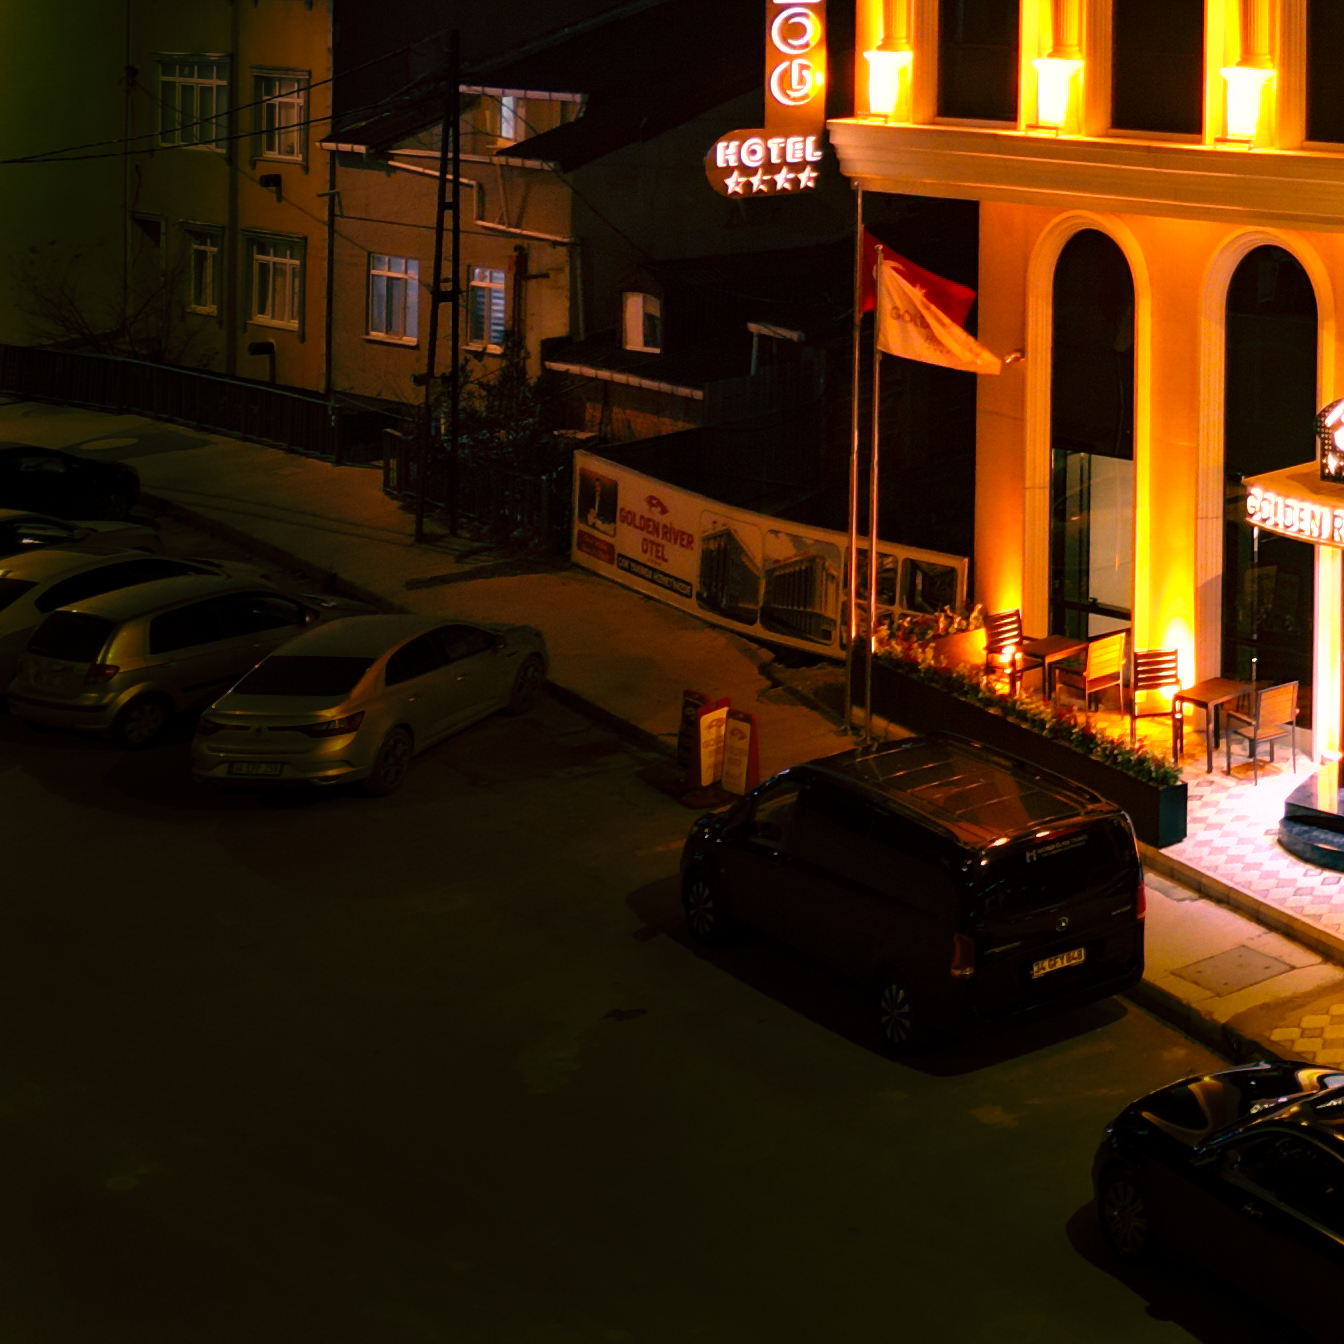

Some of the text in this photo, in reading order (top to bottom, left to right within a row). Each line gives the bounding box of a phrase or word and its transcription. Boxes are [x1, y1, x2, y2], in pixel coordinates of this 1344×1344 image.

[715, 135, 822, 167] HOTEL
[619, 507, 660, 537] GOLDEN
[1246, 487, 1333, 540] GOLDEN
[641, 538, 668, 562] OTEL
